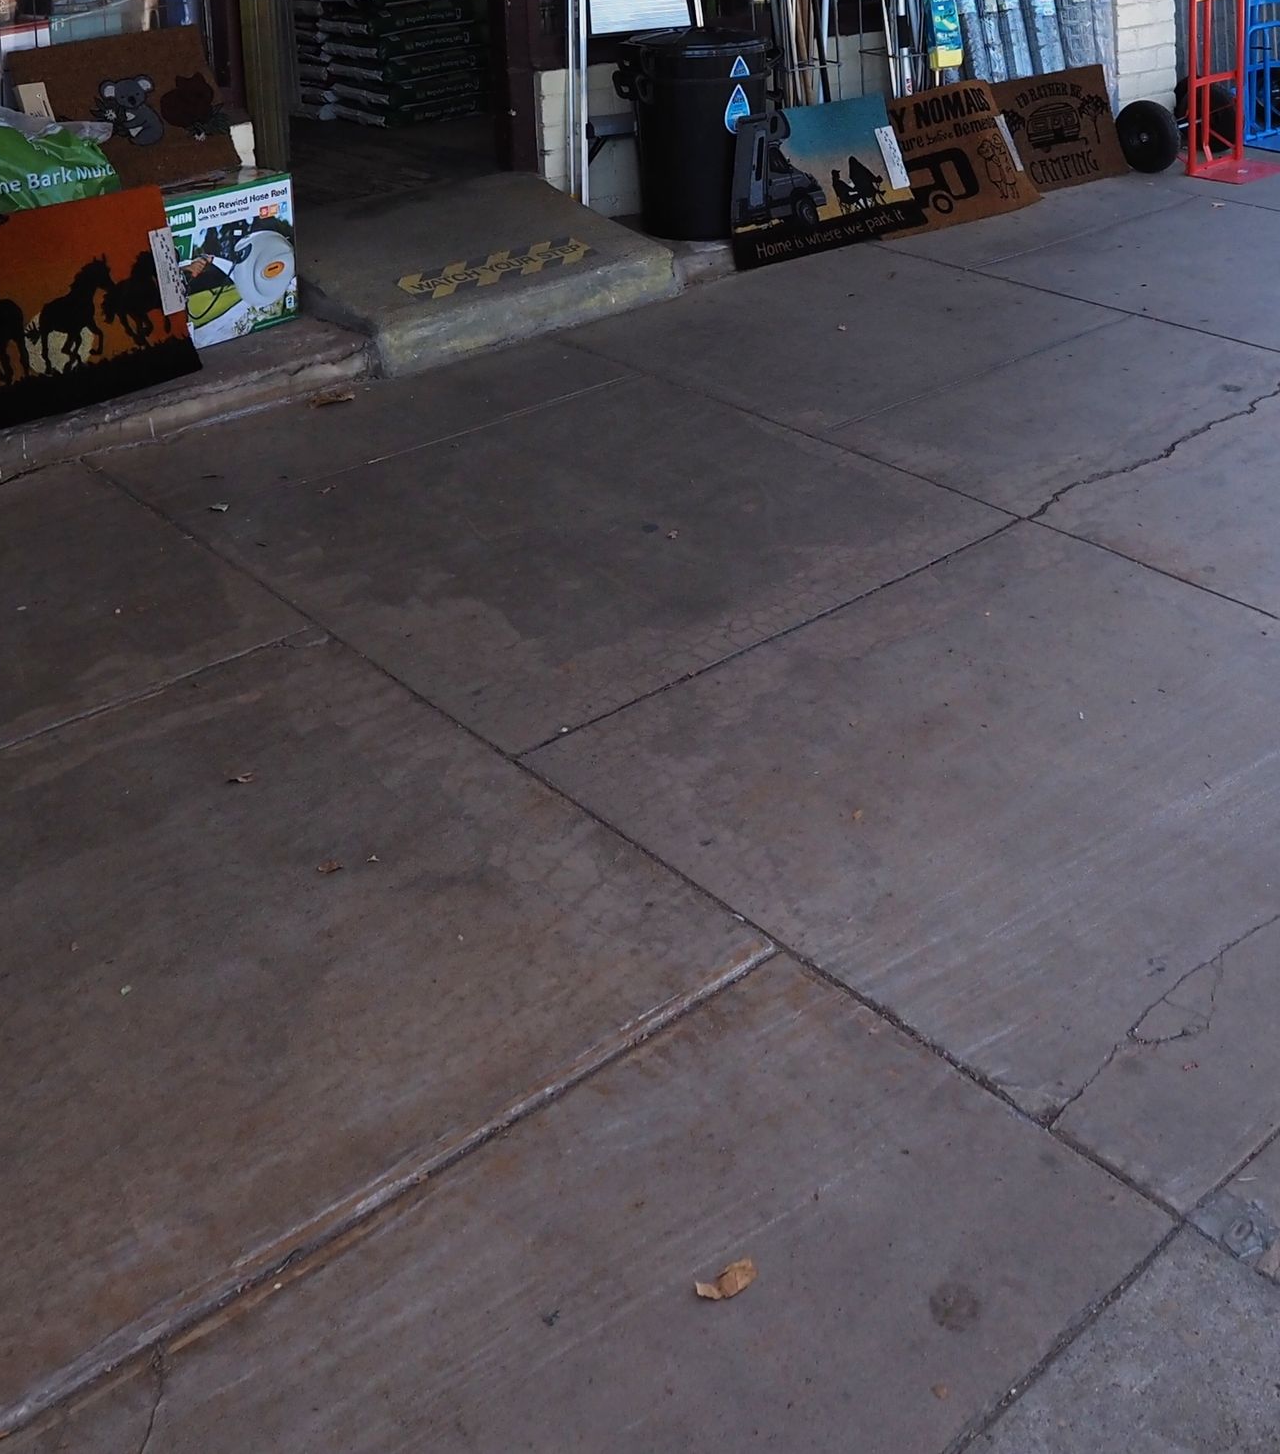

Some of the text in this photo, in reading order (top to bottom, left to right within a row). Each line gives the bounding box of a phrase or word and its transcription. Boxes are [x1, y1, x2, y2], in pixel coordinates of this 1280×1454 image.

[914, 87, 992, 129] NOMADS
[1030, 82, 1064, 102] RATHER
[26, 165, 74, 191] Bark
[76, 162, 118, 183] Mulc
[1029, 148, 1100, 186] CAMPING
[198, 186, 288, 215] Auto Rewind Hose Reel
[755, 209, 906, 259] Home is where we park it
[410, 244, 581, 292] WATCH YOUR STEP
